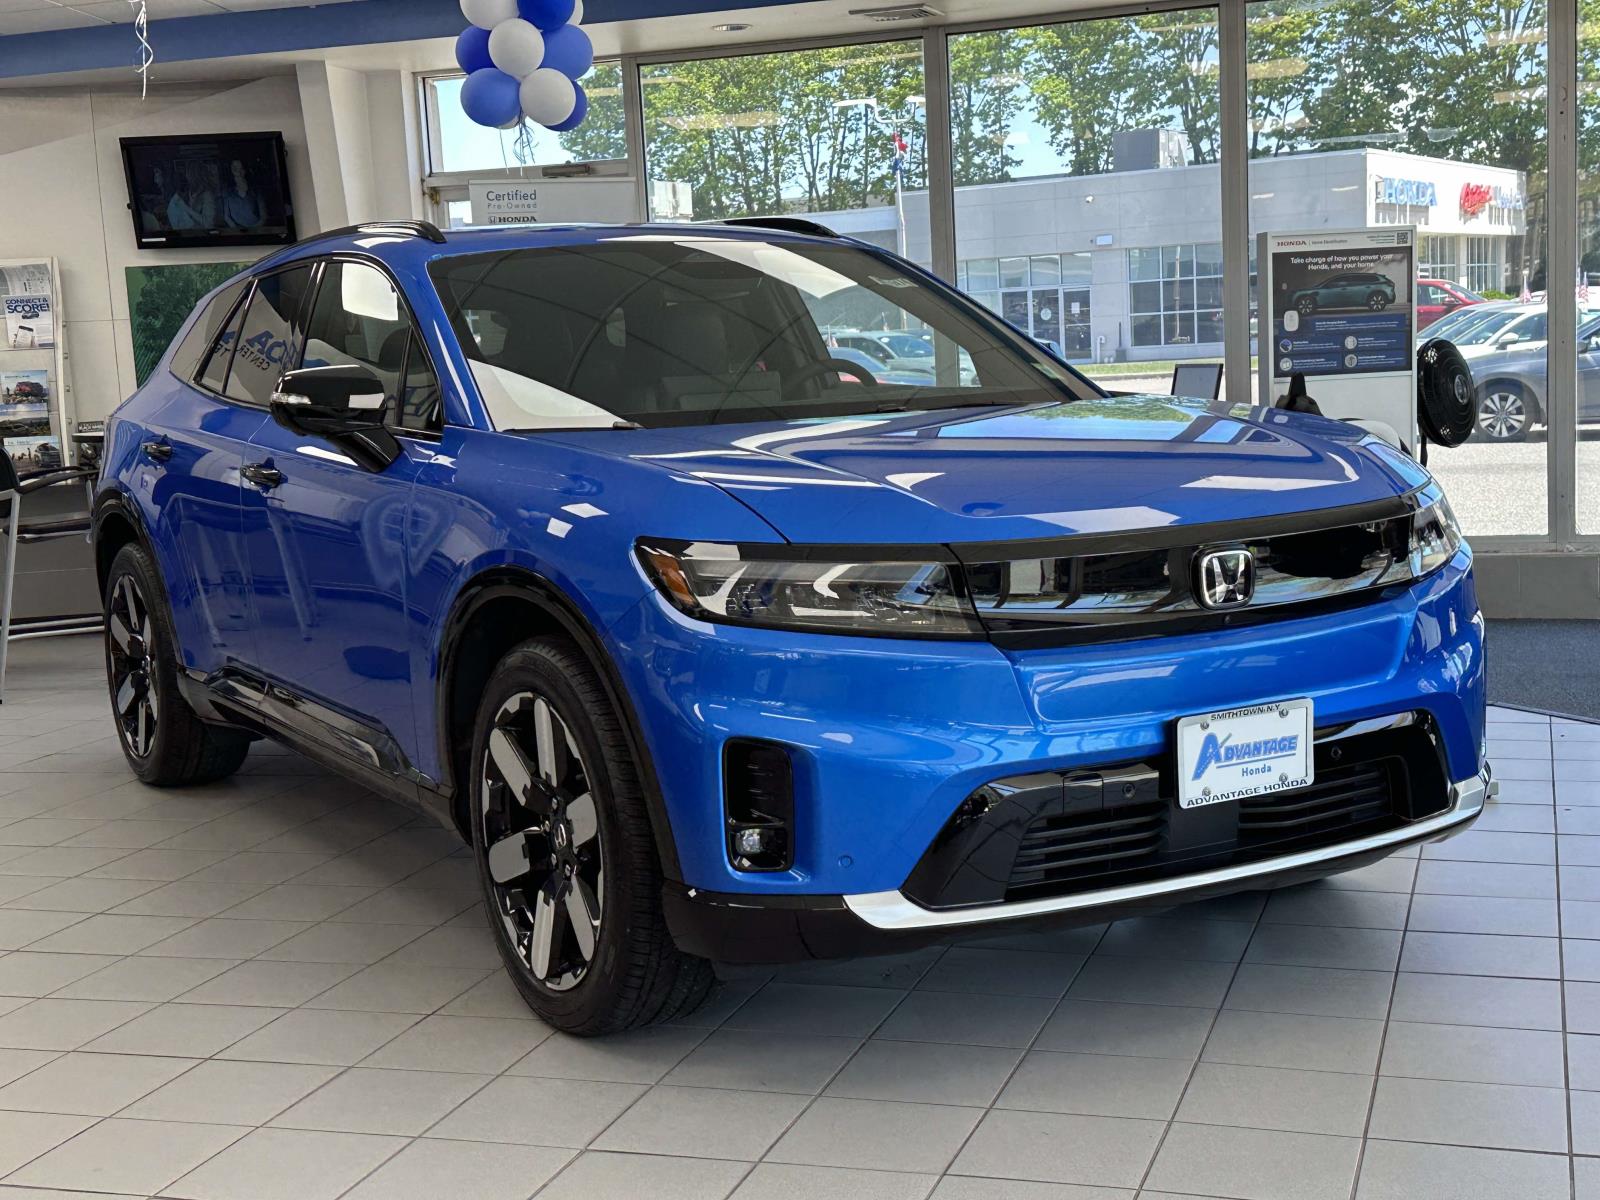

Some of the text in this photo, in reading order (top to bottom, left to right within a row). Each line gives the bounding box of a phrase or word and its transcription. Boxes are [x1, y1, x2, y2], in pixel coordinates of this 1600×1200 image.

[486, 190, 537, 201] Certified
[1383, 177, 1438, 206] HONDA
[1360, 254, 1379, 262] power
[6, 303, 51, 314] SCORE!
[1192, 733, 1298, 781] ADVANTAGE
[1242, 765, 1272, 777] Honda
[1187, 778, 1308, 807] ADVANTAGE HONDA
